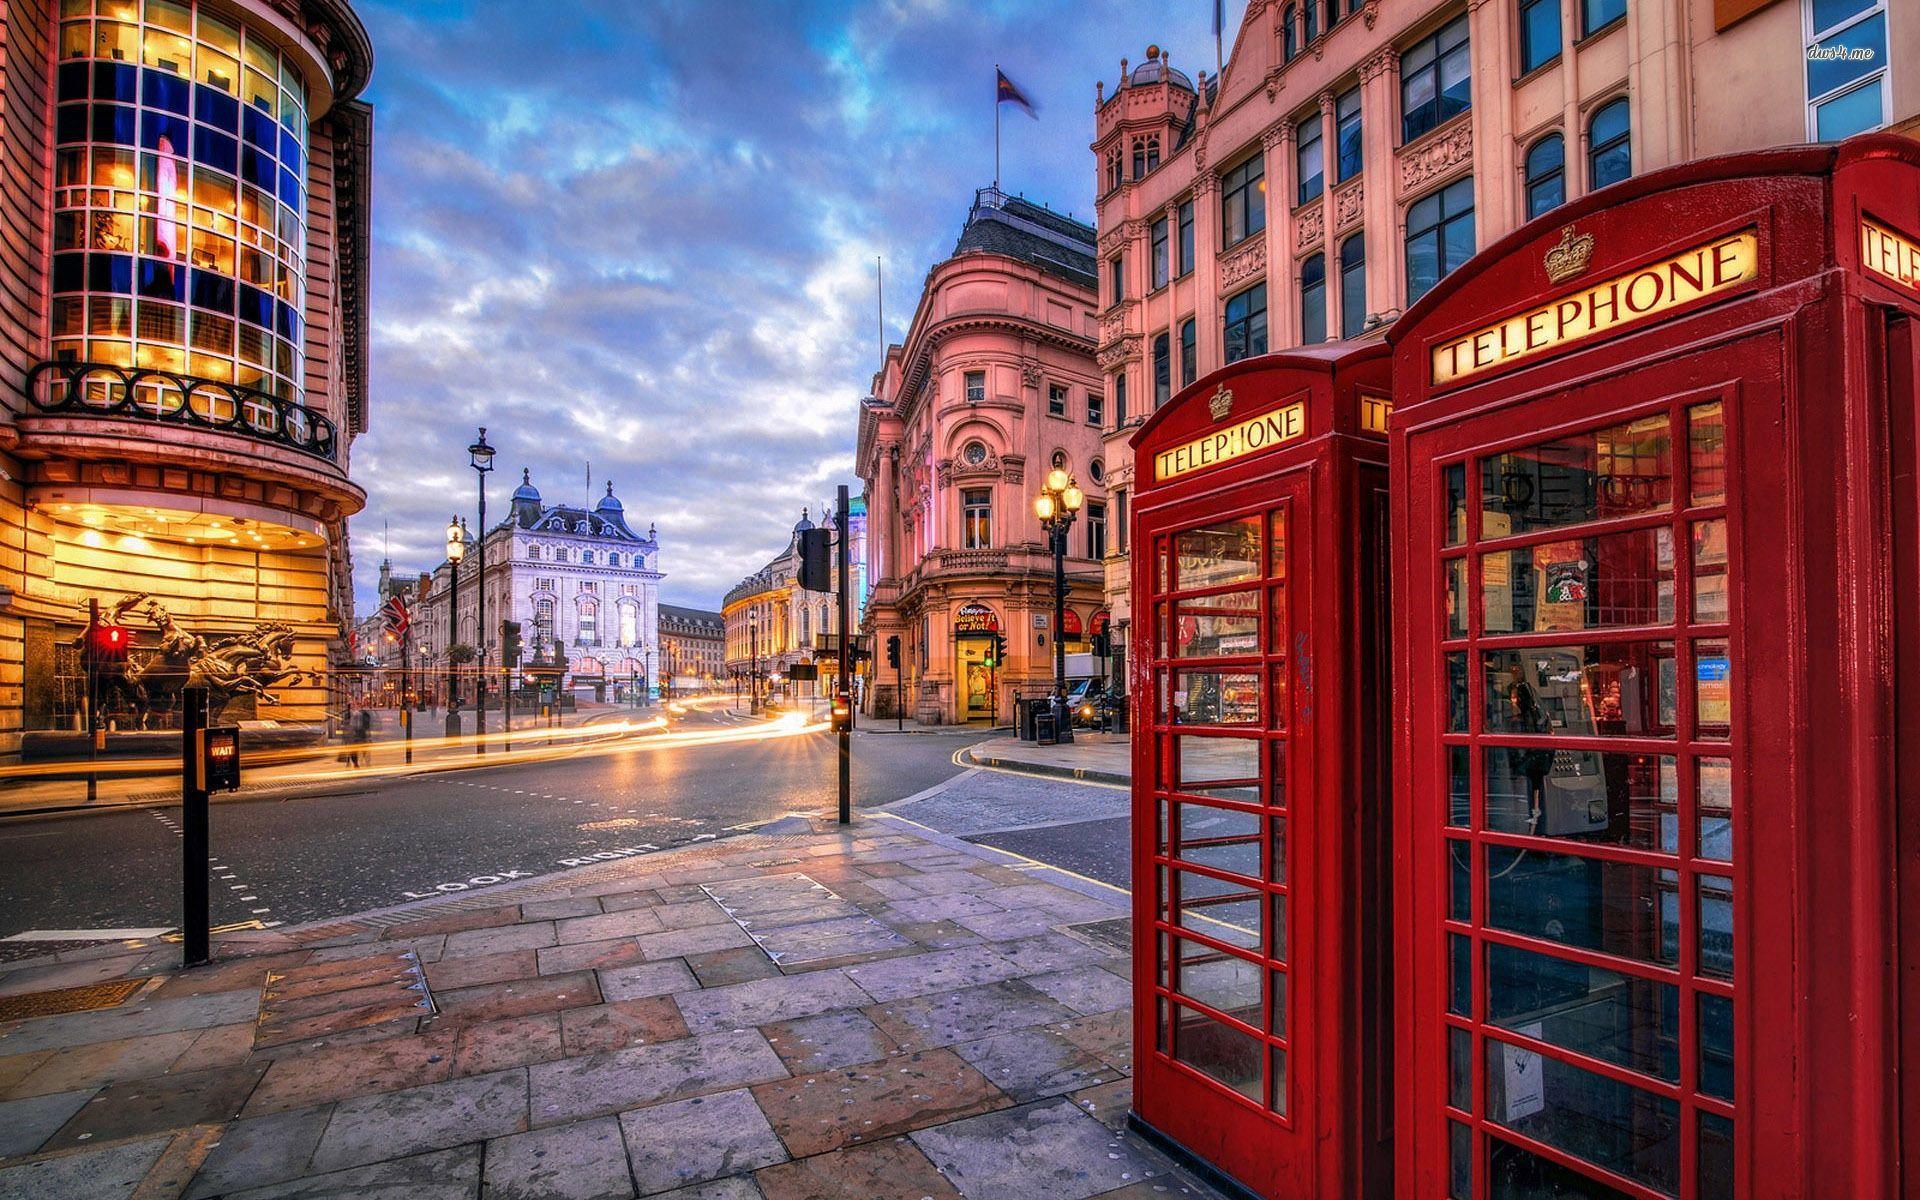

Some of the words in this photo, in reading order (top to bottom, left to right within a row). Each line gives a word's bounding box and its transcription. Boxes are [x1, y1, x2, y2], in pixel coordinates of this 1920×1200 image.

[1442, 237, 1744, 376] TELEPHONE
[211, 745, 233, 757] WAIT
[402, 870, 534, 898] LOOK
[557, 843, 660, 867] RIGHT
